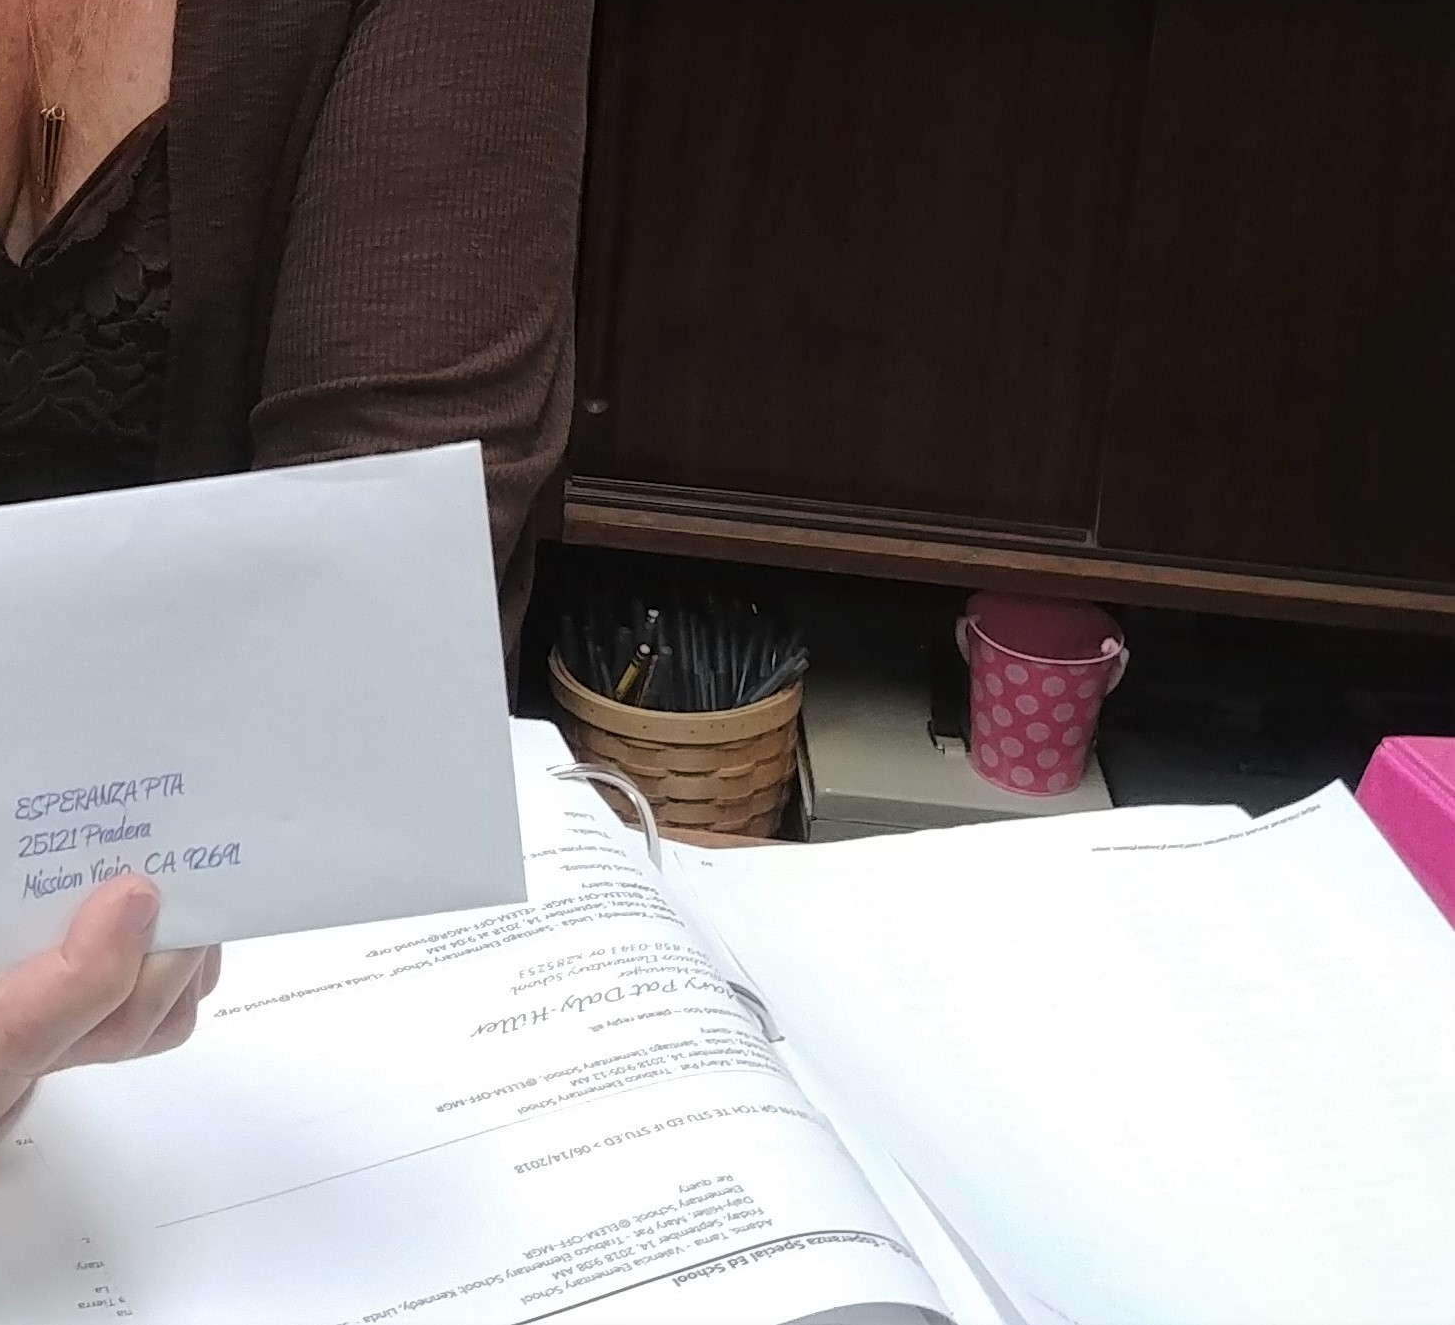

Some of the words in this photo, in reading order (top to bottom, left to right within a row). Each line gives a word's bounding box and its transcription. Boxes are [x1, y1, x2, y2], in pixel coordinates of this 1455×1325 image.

[15, 780, 138, 820] ESPERANZA
[140, 773, 185, 799] PTA
[19, 828, 78, 858] 25121
[81, 815, 152, 847] Pradera
[23, 866, 83, 901] Mission
[144, 850, 177, 875] CA
[183, 843, 242, 870] 92691
[425, 944, 448, 955] AM
[433, 939, 502, 966] Elementary
[508, 969, 565, 995] School
[631, 979, 677, 998] Pat
[582, 1048, 647, 1071] Elementary
[557, 1078, 625, 1104] Elementary
[568, 1074, 590, 1087] AM
[515, 1097, 558, 1116] School
[678, 1183, 744, 1209] Elementary
[631, 1226, 656, 1240] Pat
[656, 1214, 688, 1233] Mary
[657, 1217, 723, 1246] September
[574, 1235, 625, 1258] Trabuco
[603, 1246, 634, 1263] 2018
[633, 1244, 685, 1268] Valencia
[749, 1238, 805, 1263] Special
[505, 1252, 573, 1281] Elementary
[550, 1265, 574, 1280] AM
[575, 1256, 604, 1272] 9:08
[726, 1254, 749, 1269] Ed
[562, 1261, 632, 1292] Elementary
[670, 1262, 726, 1287] School
[94, 1285, 109, 1295] La
[519, 1284, 563, 1306] School
[77, 1297, 115, 1311] Tierra
[361, 1306, 399, 1324] Linda
